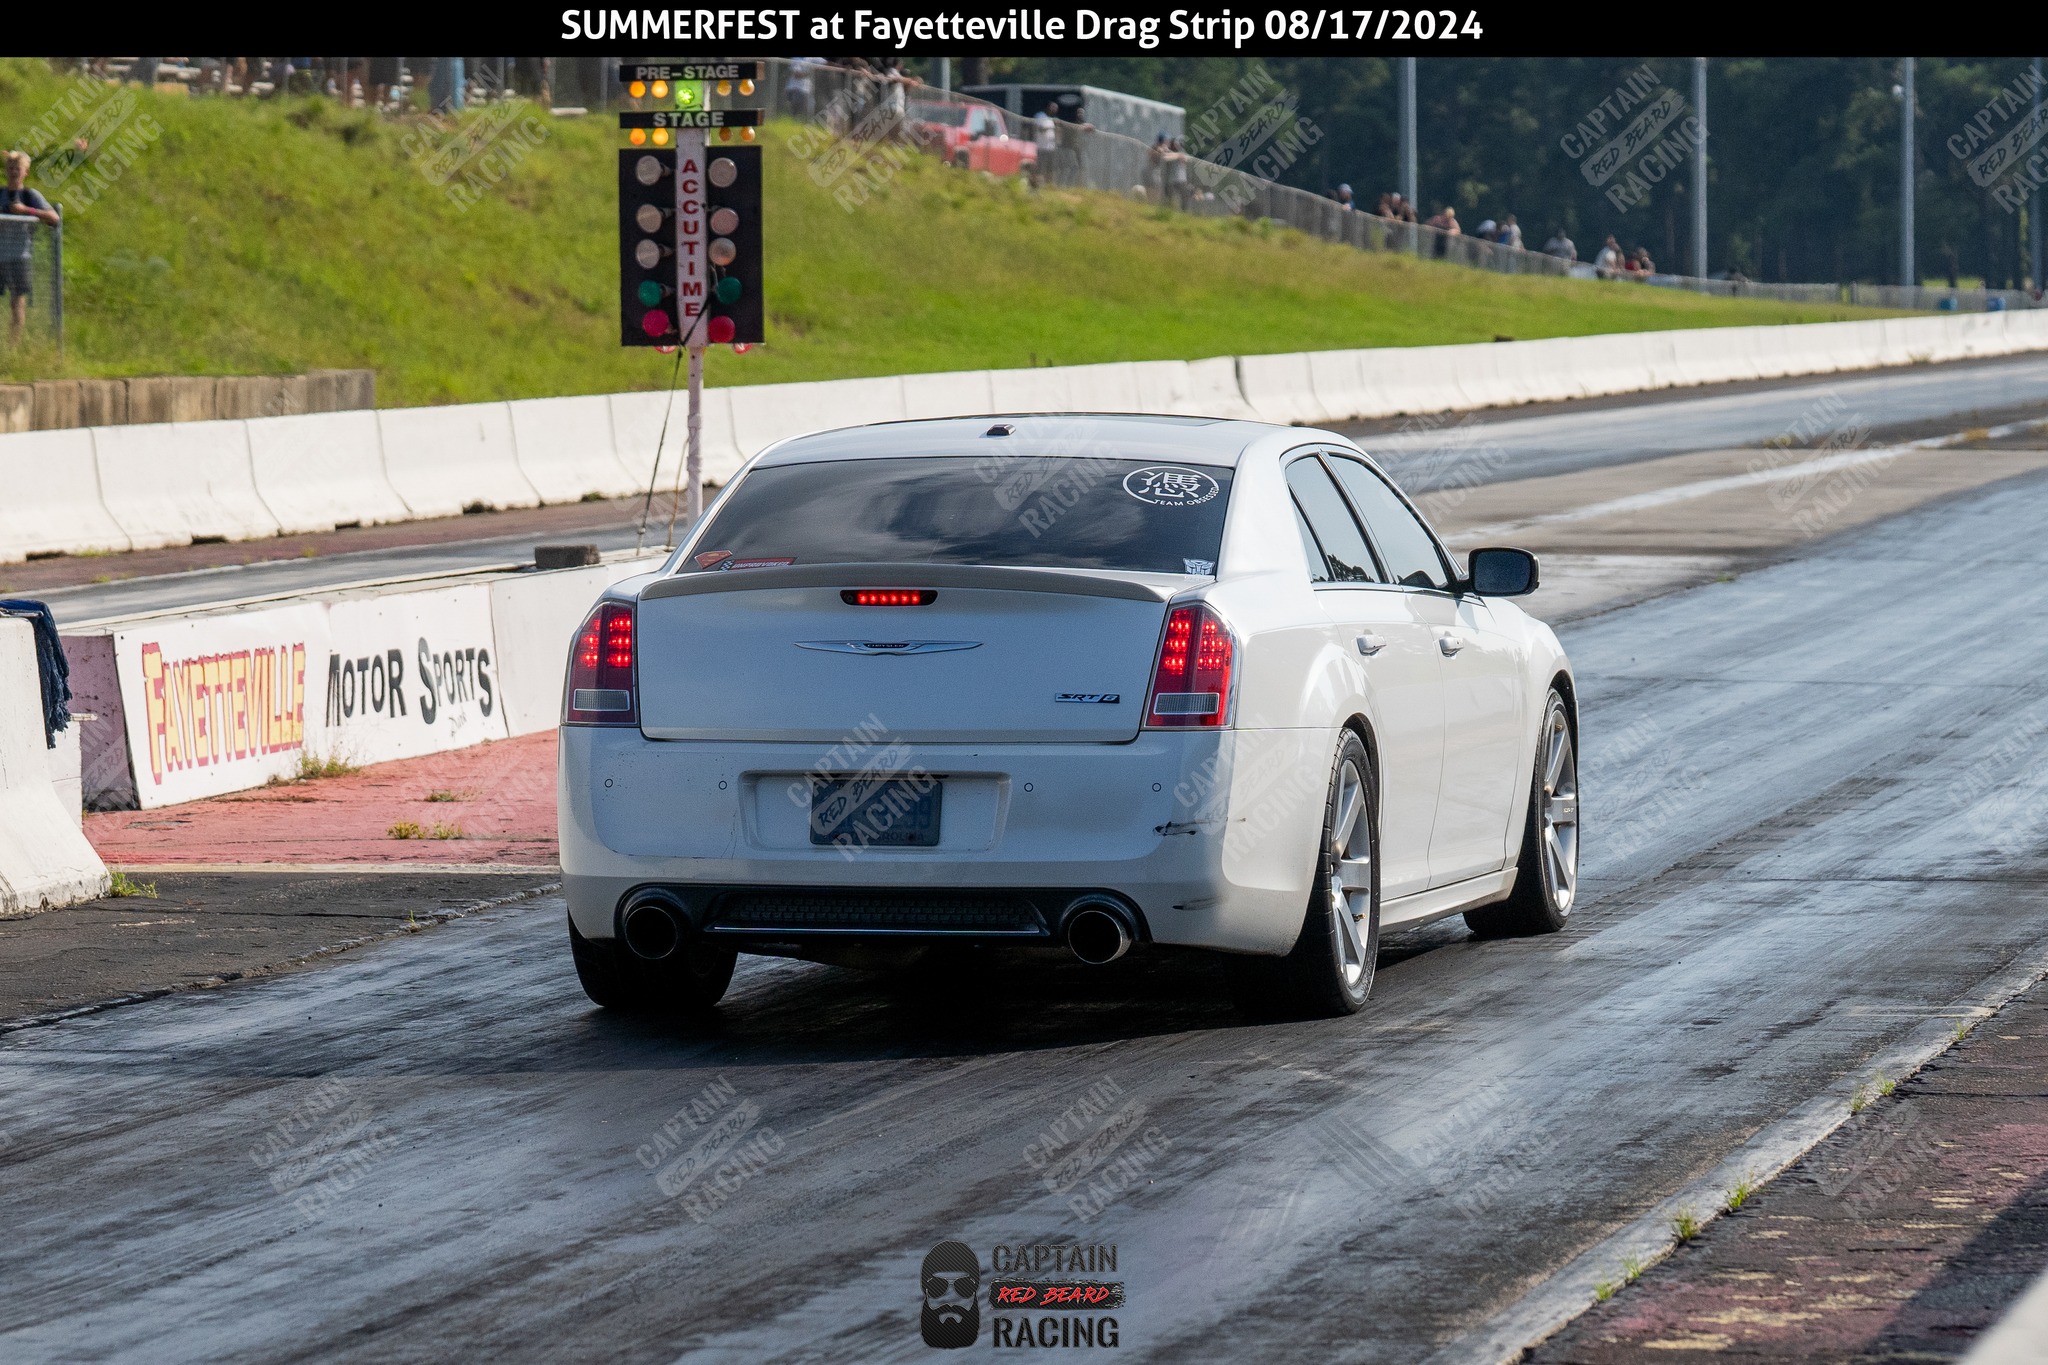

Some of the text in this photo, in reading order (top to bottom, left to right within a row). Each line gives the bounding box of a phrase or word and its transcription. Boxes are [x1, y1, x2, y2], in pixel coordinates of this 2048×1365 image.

[637, 65, 739, 79] PRE-STAGE
[653, 112, 725, 127] STAGE
[682, 159, 702, 316] ACCUTIME
[142, 641, 306, 785] FAYETTEVILLE
[326, 648, 407, 728] MOTOR
[418, 636, 494, 724] SPORTS
